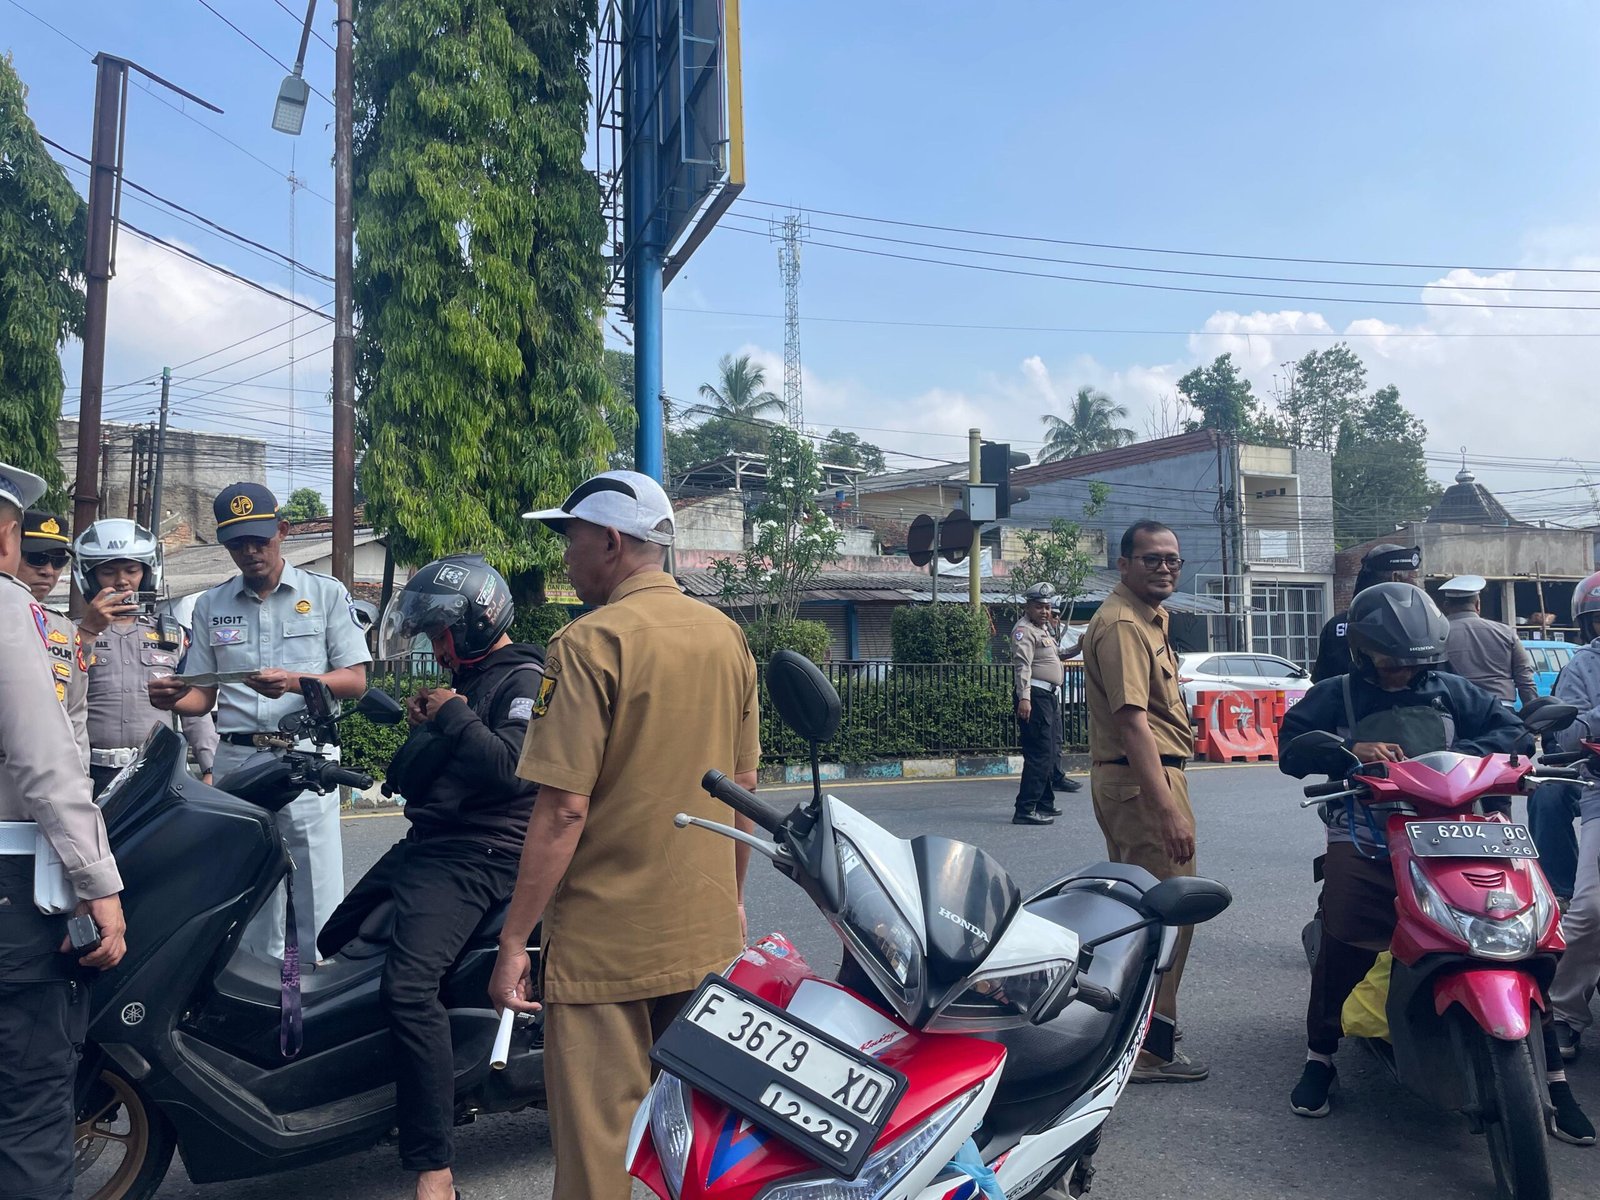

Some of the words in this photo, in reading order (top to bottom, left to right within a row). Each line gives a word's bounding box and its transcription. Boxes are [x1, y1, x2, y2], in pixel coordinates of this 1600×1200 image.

[212, 615, 243, 626] SIGIT
[1410, 825, 1423, 839] F
[1437, 825, 1487, 839] 6204
[938, 906, 990, 943] HONDA
[693, 993, 725, 1022] F
[727, 1011, 810, 1073] 3679
[831, 1067, 883, 1115] XD
